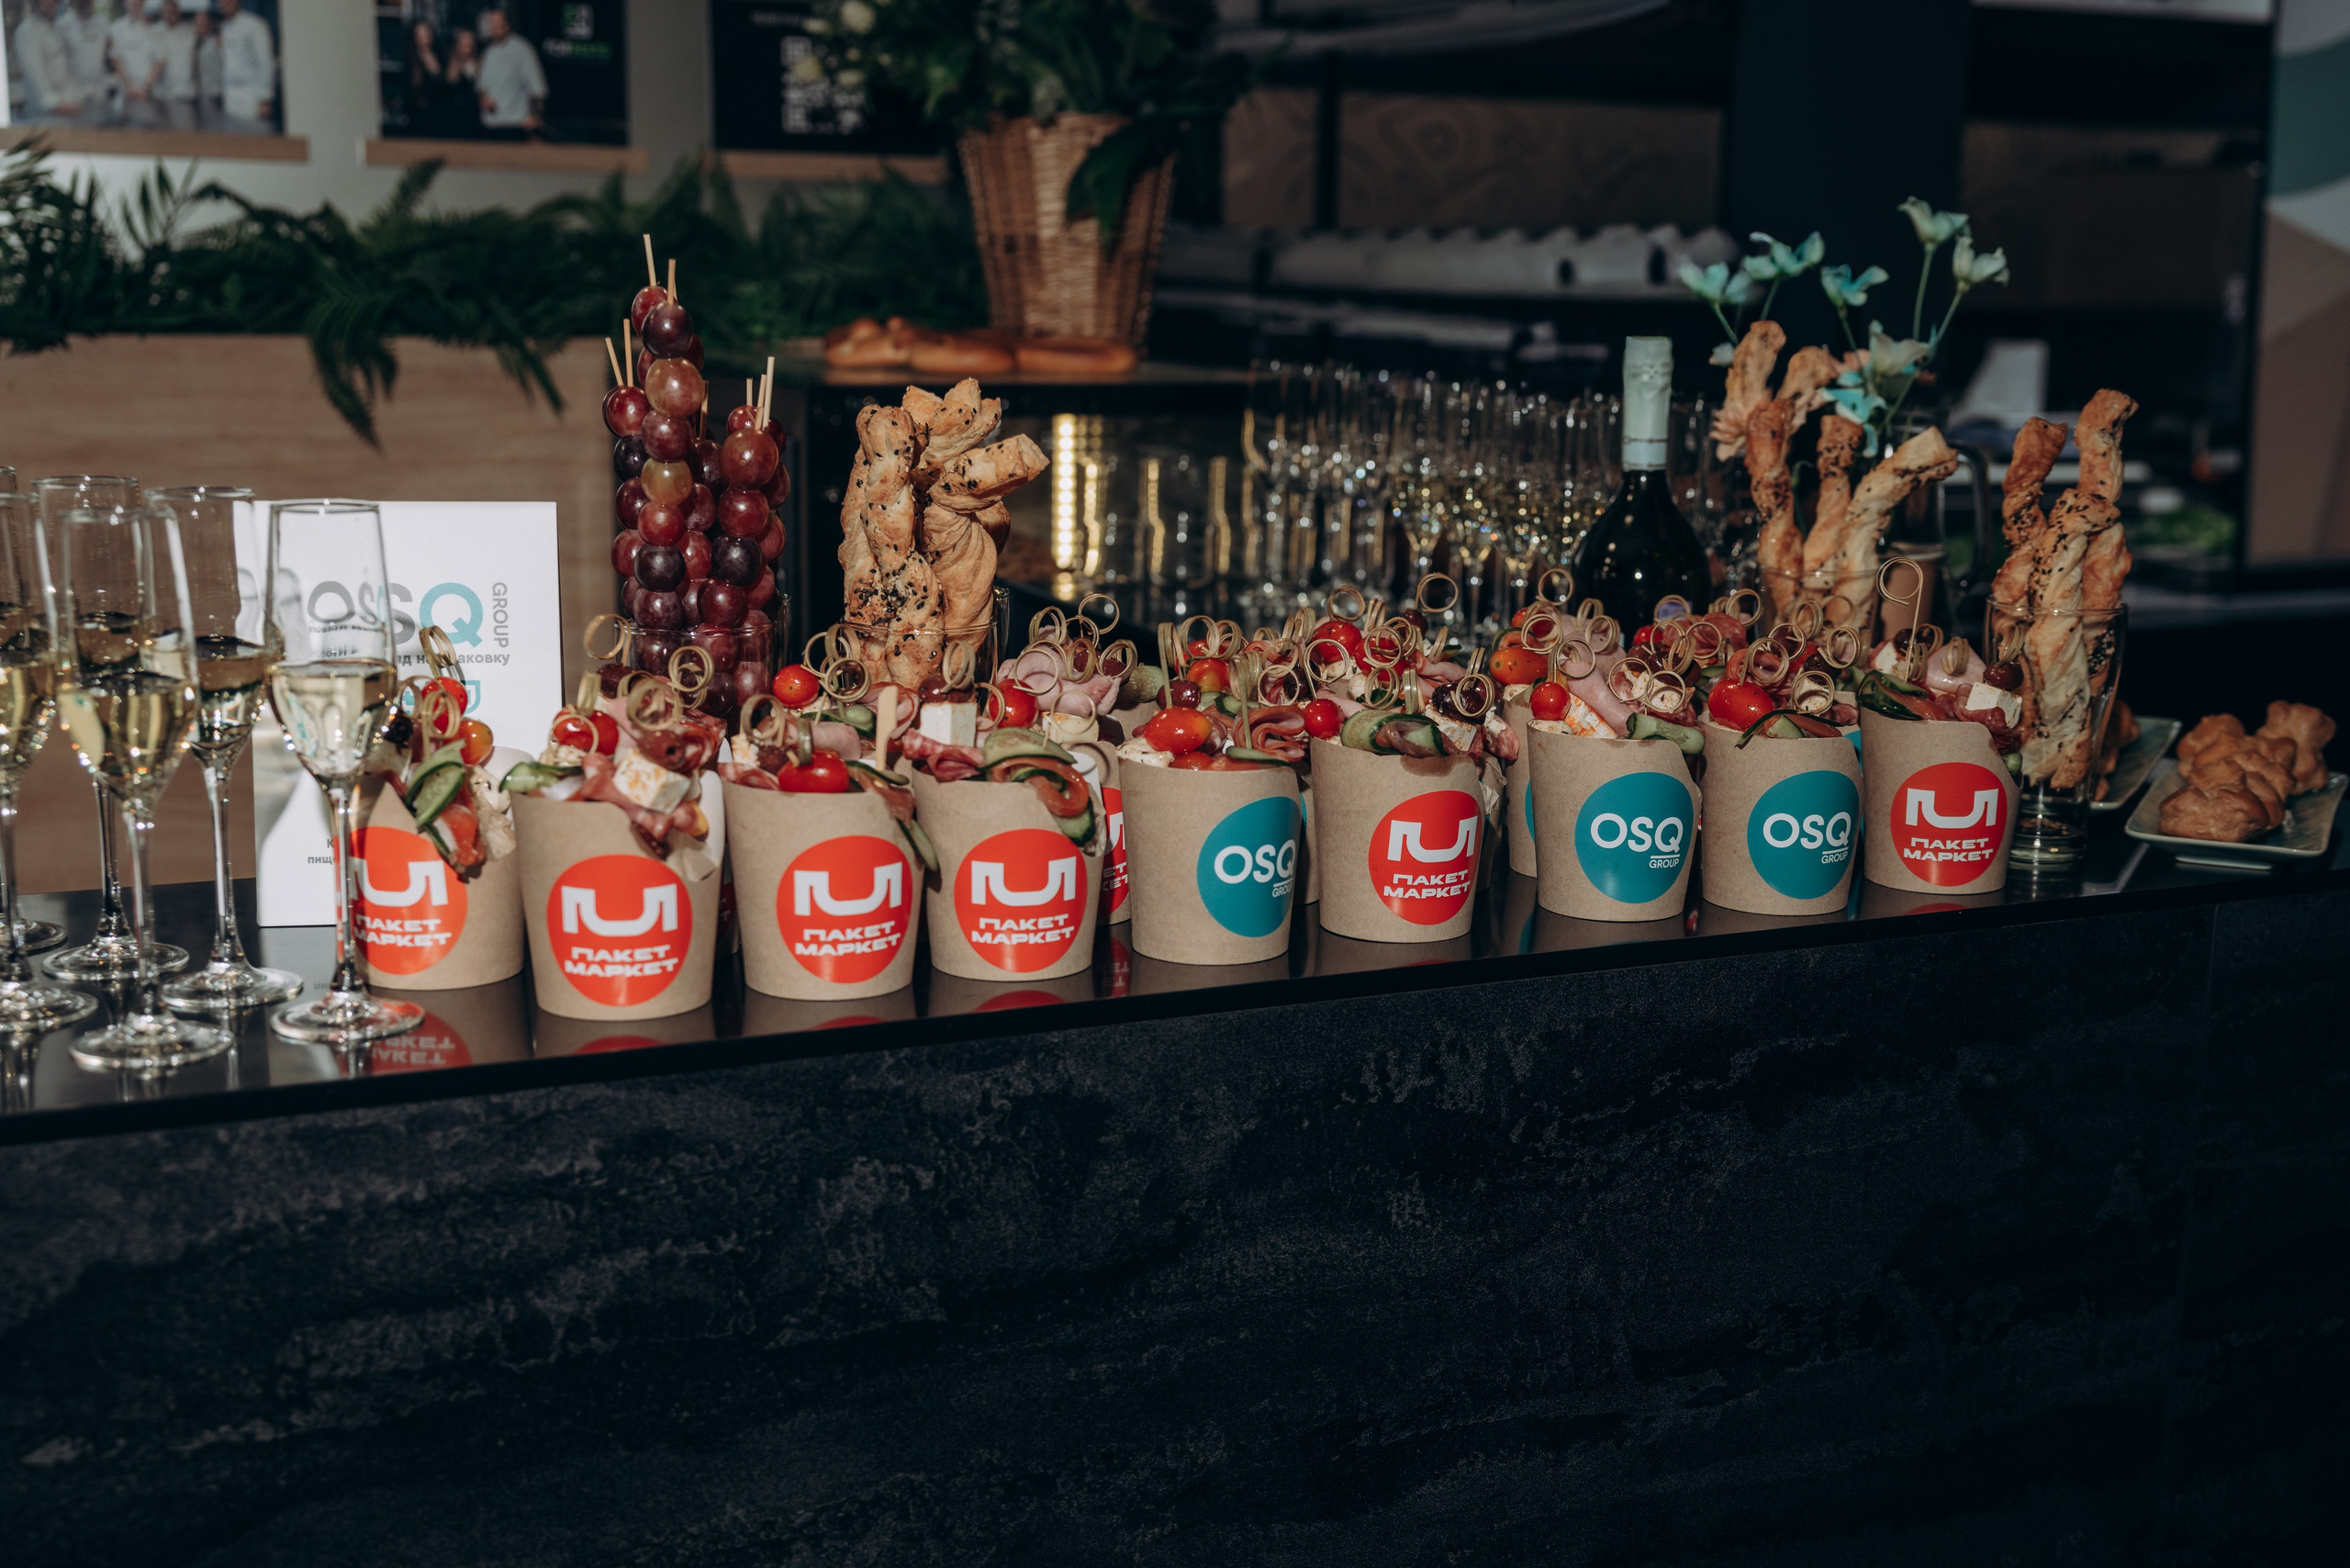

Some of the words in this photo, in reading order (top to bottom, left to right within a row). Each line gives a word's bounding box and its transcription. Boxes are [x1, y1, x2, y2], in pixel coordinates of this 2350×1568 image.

[492, 582, 509, 648] GROUP
[457, 654, 510, 666] аковку
[1590, 812, 1684, 854] OSQ
[1762, 812, 1852, 849] OSQ
[1910, 837, 1989, 850] ПАКЕТ
[1214, 839, 1296, 884] OSQ
[1649, 858, 1680, 868] GROUP
[1821, 851, 1849, 864] GROUP
[1903, 848, 1994, 862] МАРКЕТ
[1393, 869, 1469, 886] ПАКЕТ
[1383, 880, 1471, 899] МАРКЕТ
[356, 914, 442, 932] ПАКЕТ
[803, 921, 895, 941] ПАКЕТ
[979, 913, 1069, 931] ПАКЕТ
[353, 926, 452, 946] МАРКЕТ
[795, 933, 901, 956] МАРКЕТ
[971, 926, 1075, 945] МАРКЕТ
[571, 945, 670, 962] ПАКЕТ
[564, 958, 678, 978] МАРКЕТ
